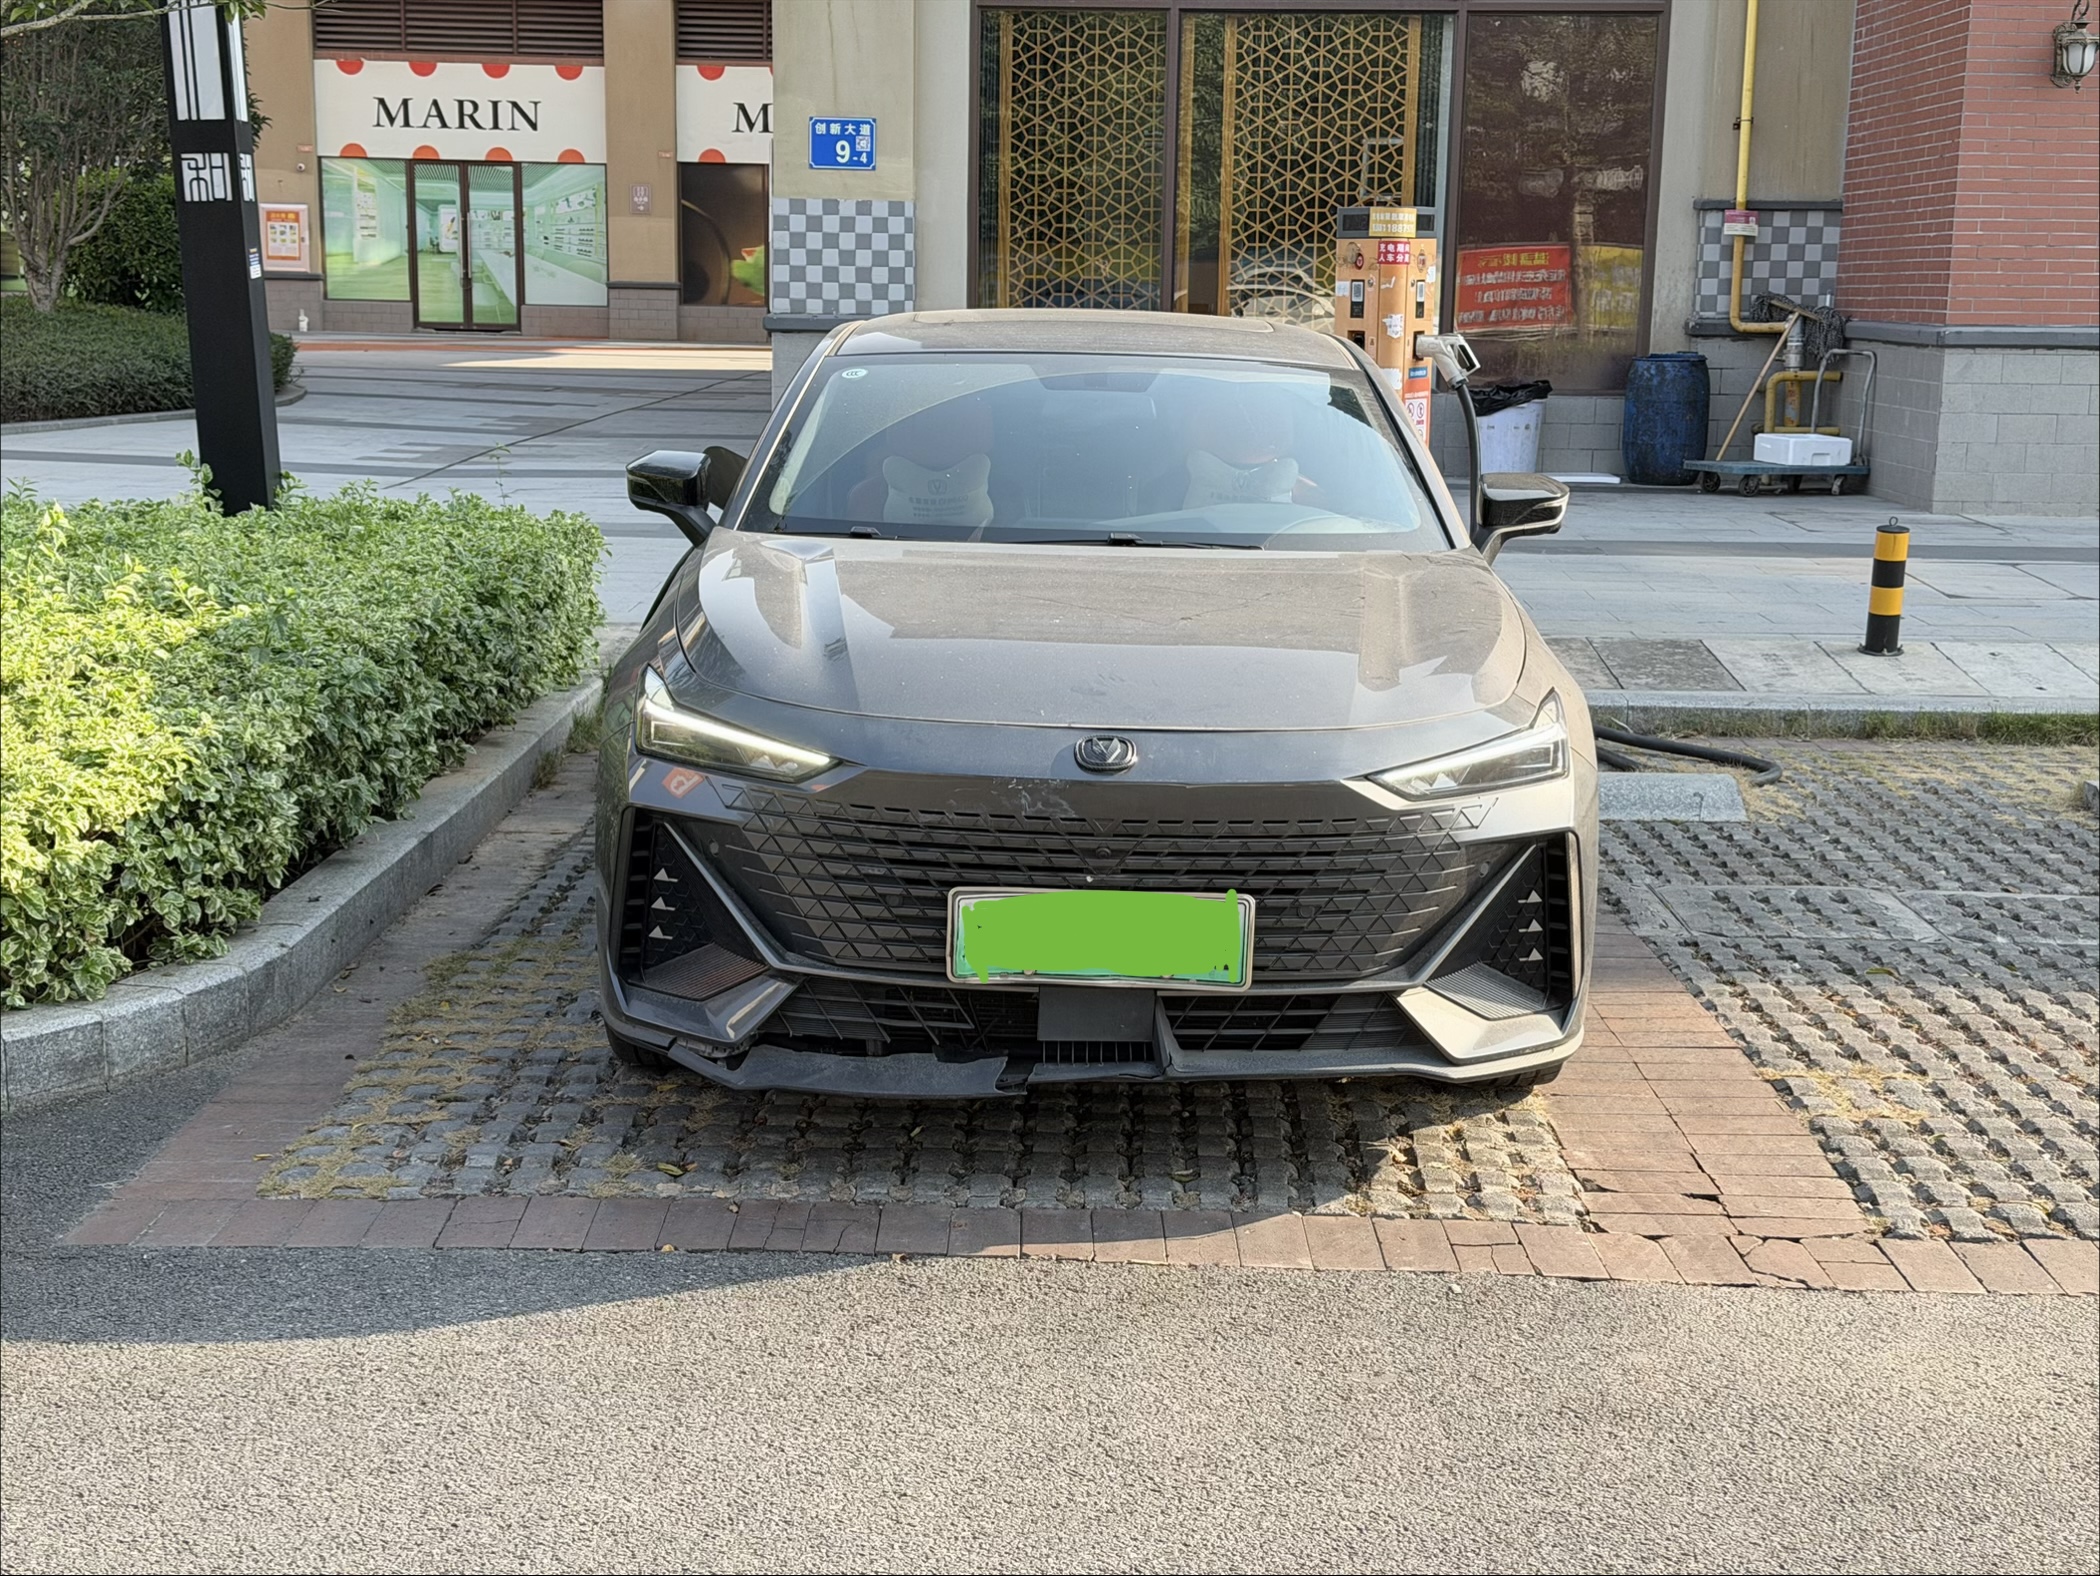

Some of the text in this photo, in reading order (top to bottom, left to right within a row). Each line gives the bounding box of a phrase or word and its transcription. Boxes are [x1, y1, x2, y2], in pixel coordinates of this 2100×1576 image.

[372, 96, 542, 132] MARIN
[815, 122, 871, 136] 创新大道
